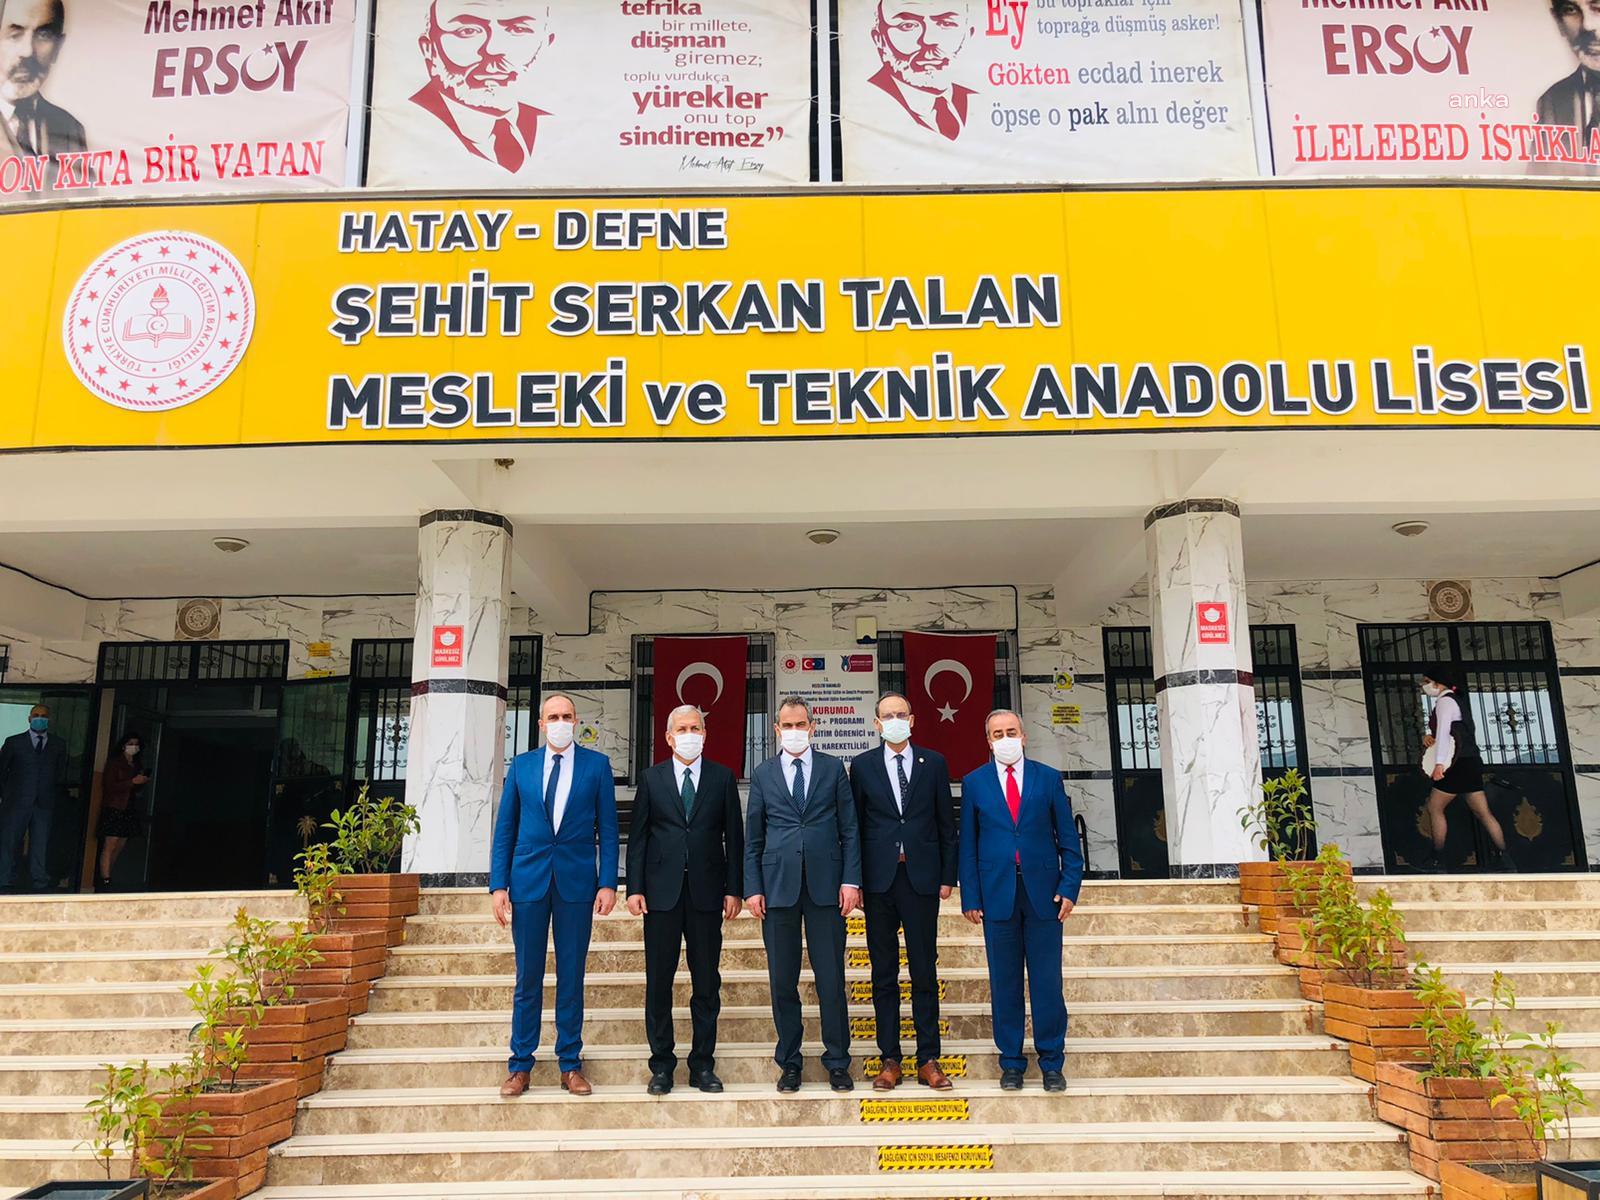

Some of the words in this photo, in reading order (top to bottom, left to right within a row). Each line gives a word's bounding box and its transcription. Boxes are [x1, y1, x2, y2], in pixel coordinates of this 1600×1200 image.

[143, 0, 267, 34] Mehmet
[620, 0, 702, 16] tefrika
[662, 20, 686, 32] bir
[690, 20, 752, 33] millete,
[985, 0, 1028, 49] Ey
[1037, 16, 1101, 38] toprağa
[1105, 15, 1167, 37] düşmüş
[1171, 13, 1221, 31] asker!
[631, 31, 726, 53] düşman
[675, 51, 764, 68] giremez;
[988, 62, 1071, 87] Gökten
[1078, 61, 1143, 85] ecdad
[1151, 60, 1225, 84] inerek
[624, 72, 661, 83] toplu
[665, 72, 730, 84] vurdukça
[632, 85, 769, 115] yürekler
[991, 103, 1041, 132] öpse
[1048, 108, 1061, 126] o
[1069, 102, 1110, 132] pak
[1116, 101, 1159, 125] alnı
[1166, 100, 1229, 130] değer
[684, 113, 718, 124] onu
[726, 112, 756, 127] top
[1292, 114, 1470, 162] İLELEBED
[53, 150, 133, 189] KITA
[143, 133, 200, 184] BİR
[211, 140, 326, 179] VATAN
[341, 212, 508, 250] HATAY
[556, 210, 726, 248] DEFNE
[158, 265, 192, 280] MİLLİ
[101, 267, 155, 334] CUMHURİYETİ
[192, 276, 216, 315] EĞİTİM
[332, 271, 531, 343] ŞEHİT
[550, 281, 823, 333] SERKAN
[841, 275, 1059, 328] TALAN
[104, 336, 142, 371] TÜRKİYE
[167, 317, 216, 371] BAKANLIĞI
[329, 359, 624, 427] MESLEKİ
[645, 382, 724, 428] ve
[748, 353, 1006, 422] TEKNİK
[1024, 362, 1354, 417] ANADOLU
[1373, 347, 1589, 412] LİSESİ
[812, 706, 855, 715] KURUMDA
